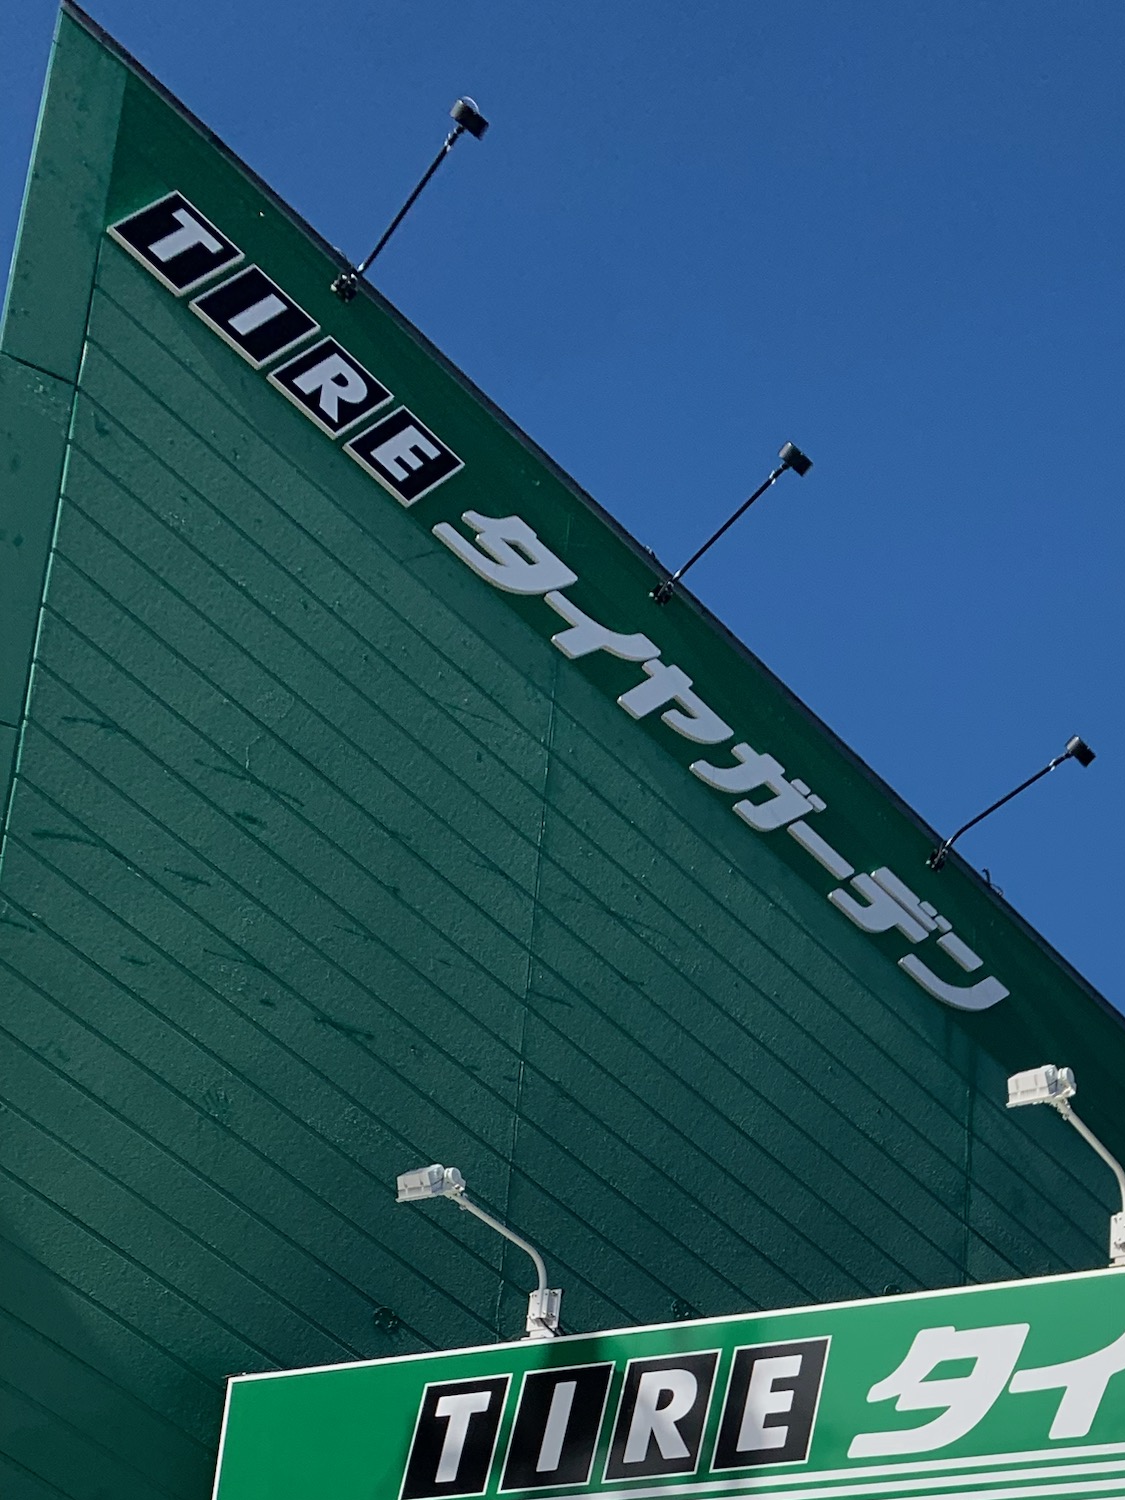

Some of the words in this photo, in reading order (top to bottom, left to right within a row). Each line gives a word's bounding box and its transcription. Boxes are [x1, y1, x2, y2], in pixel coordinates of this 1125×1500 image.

[147, 207, 442, 483] TIRE
[432, 510, 1009, 1012] タイヤガーデン
[434, 1354, 805, 1483] TIRE
